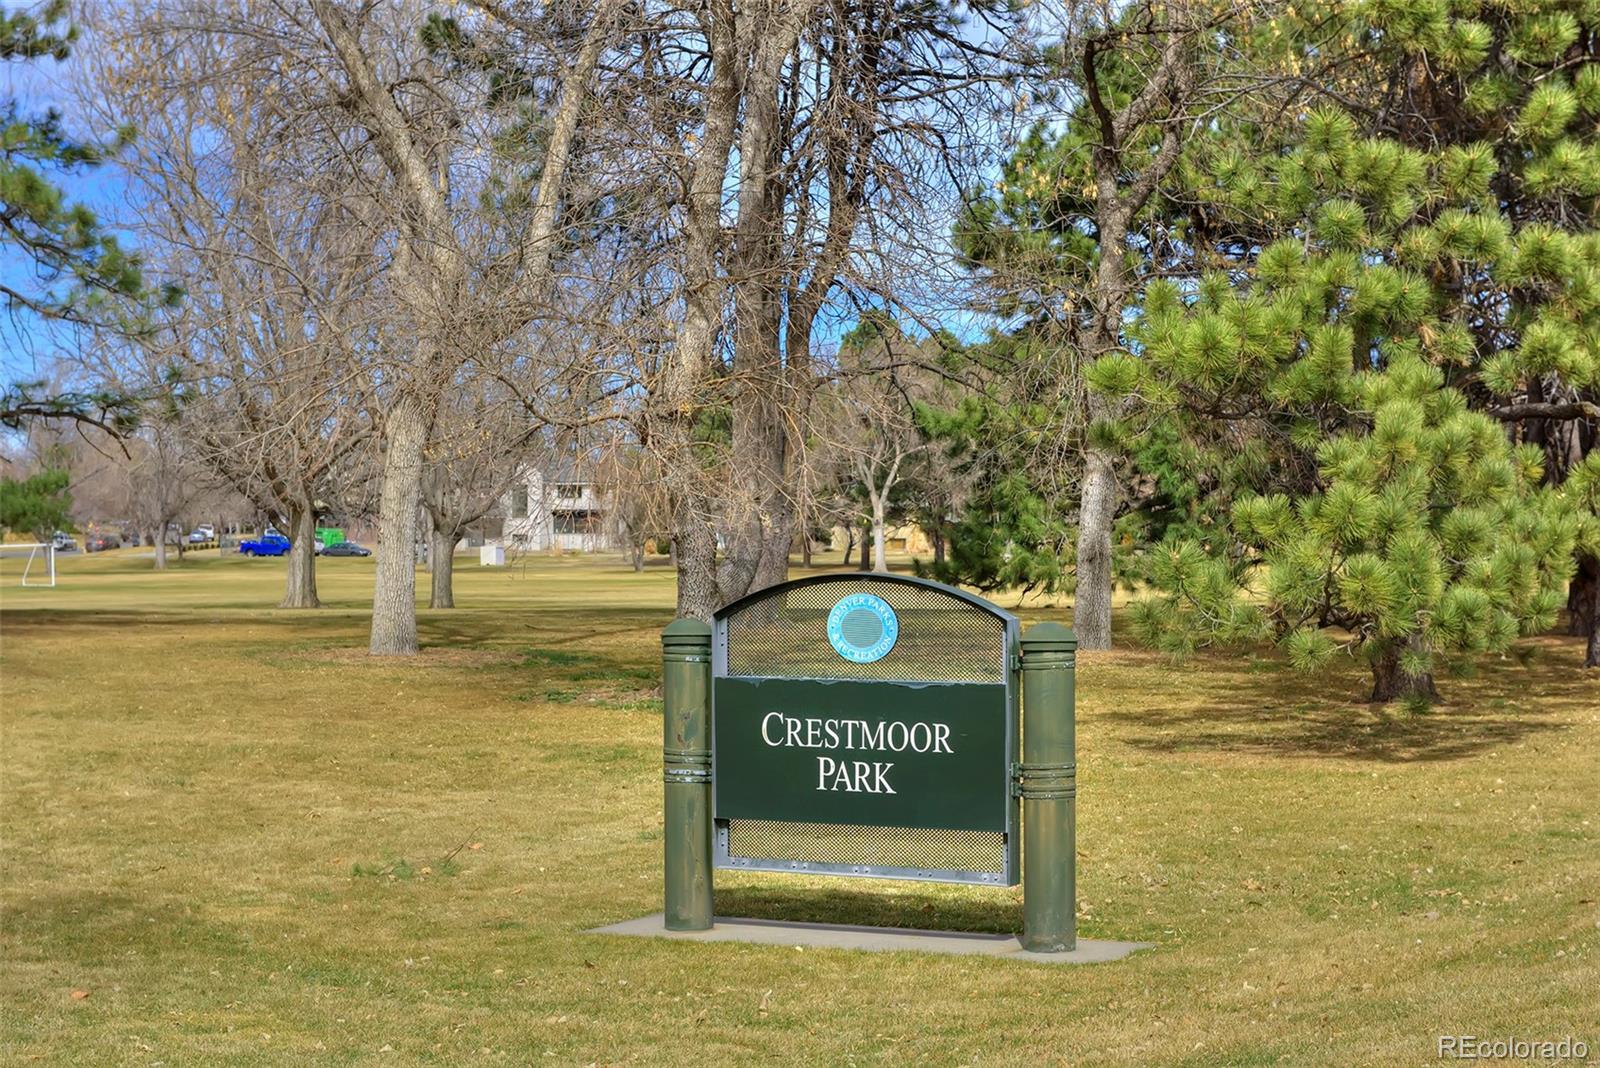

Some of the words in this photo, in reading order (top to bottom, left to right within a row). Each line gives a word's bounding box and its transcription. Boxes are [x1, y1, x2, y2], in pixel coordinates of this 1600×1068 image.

[832, 597, 866, 624] DENVER
[868, 597, 893, 626] PARKS
[837, 636, 892, 659] RECREATION
[761, 712, 954, 753] CRESTMOOR
[816, 756, 897, 794] PARK
